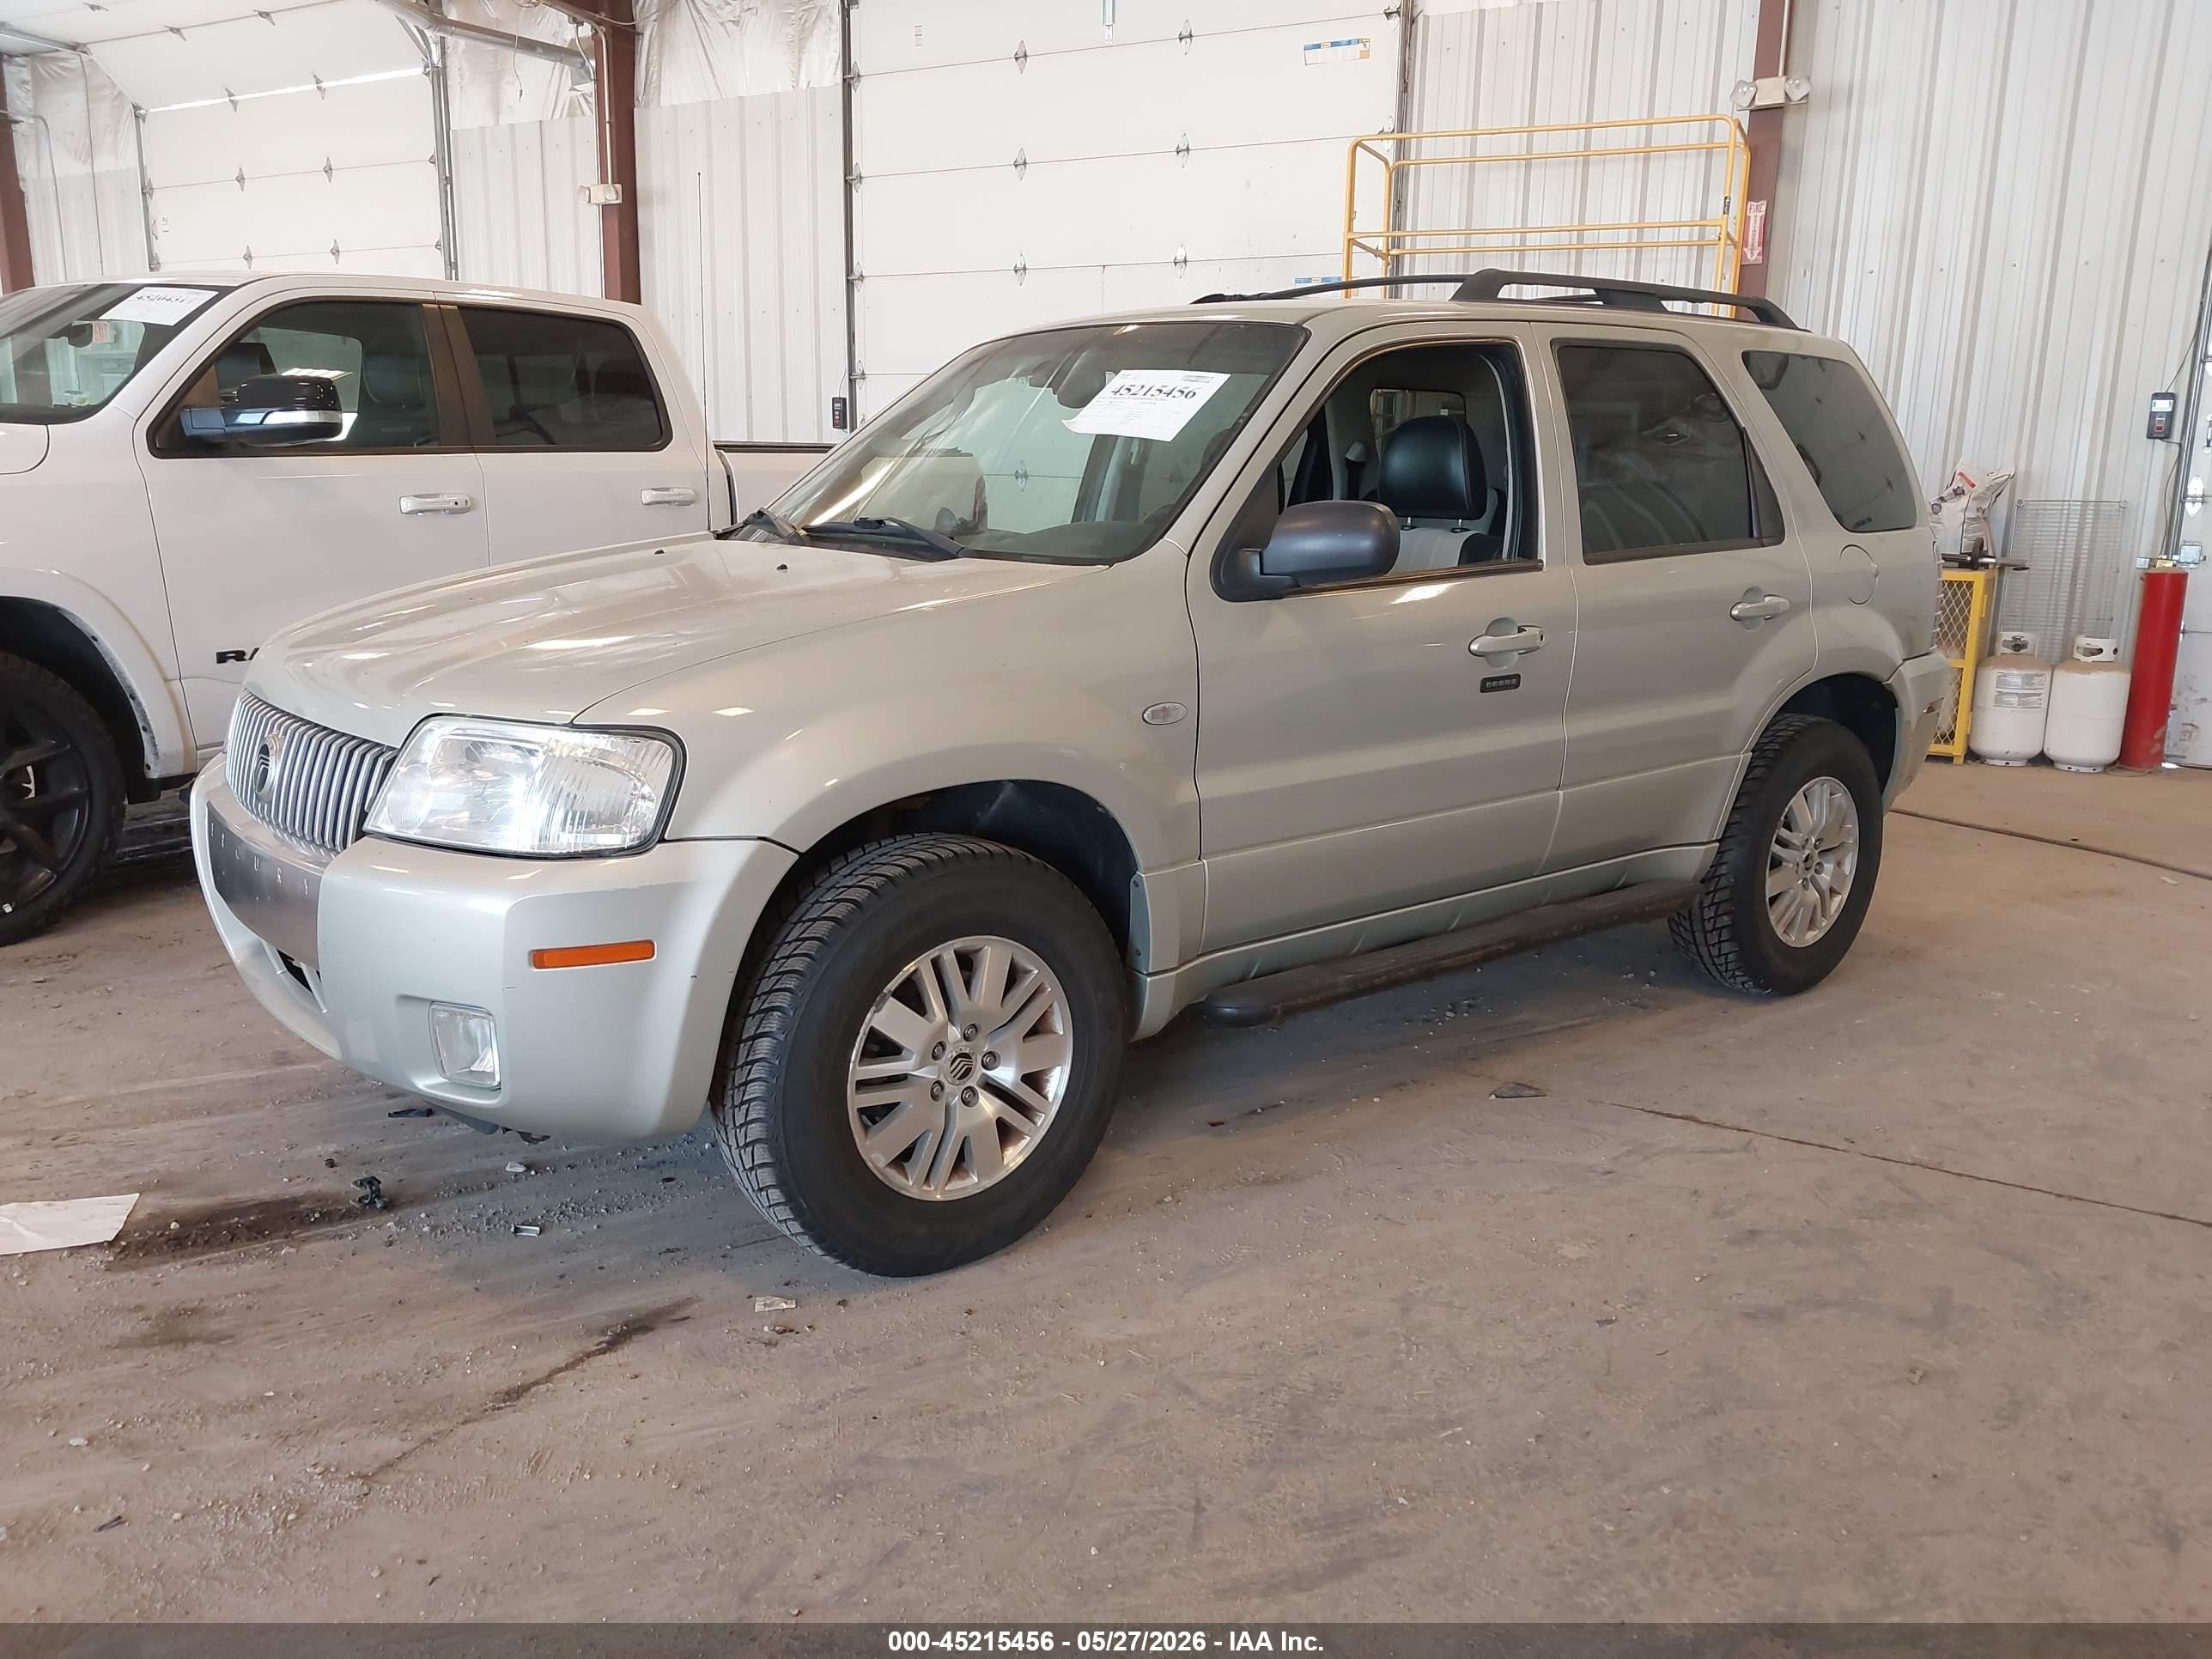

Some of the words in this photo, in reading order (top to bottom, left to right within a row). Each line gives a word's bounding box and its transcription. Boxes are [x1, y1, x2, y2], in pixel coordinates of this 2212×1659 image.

[1748, 204, 1764, 214] FIRE
[1110, 383, 1203, 400] 45215456
[210, 822, 309, 896] ERCURY
